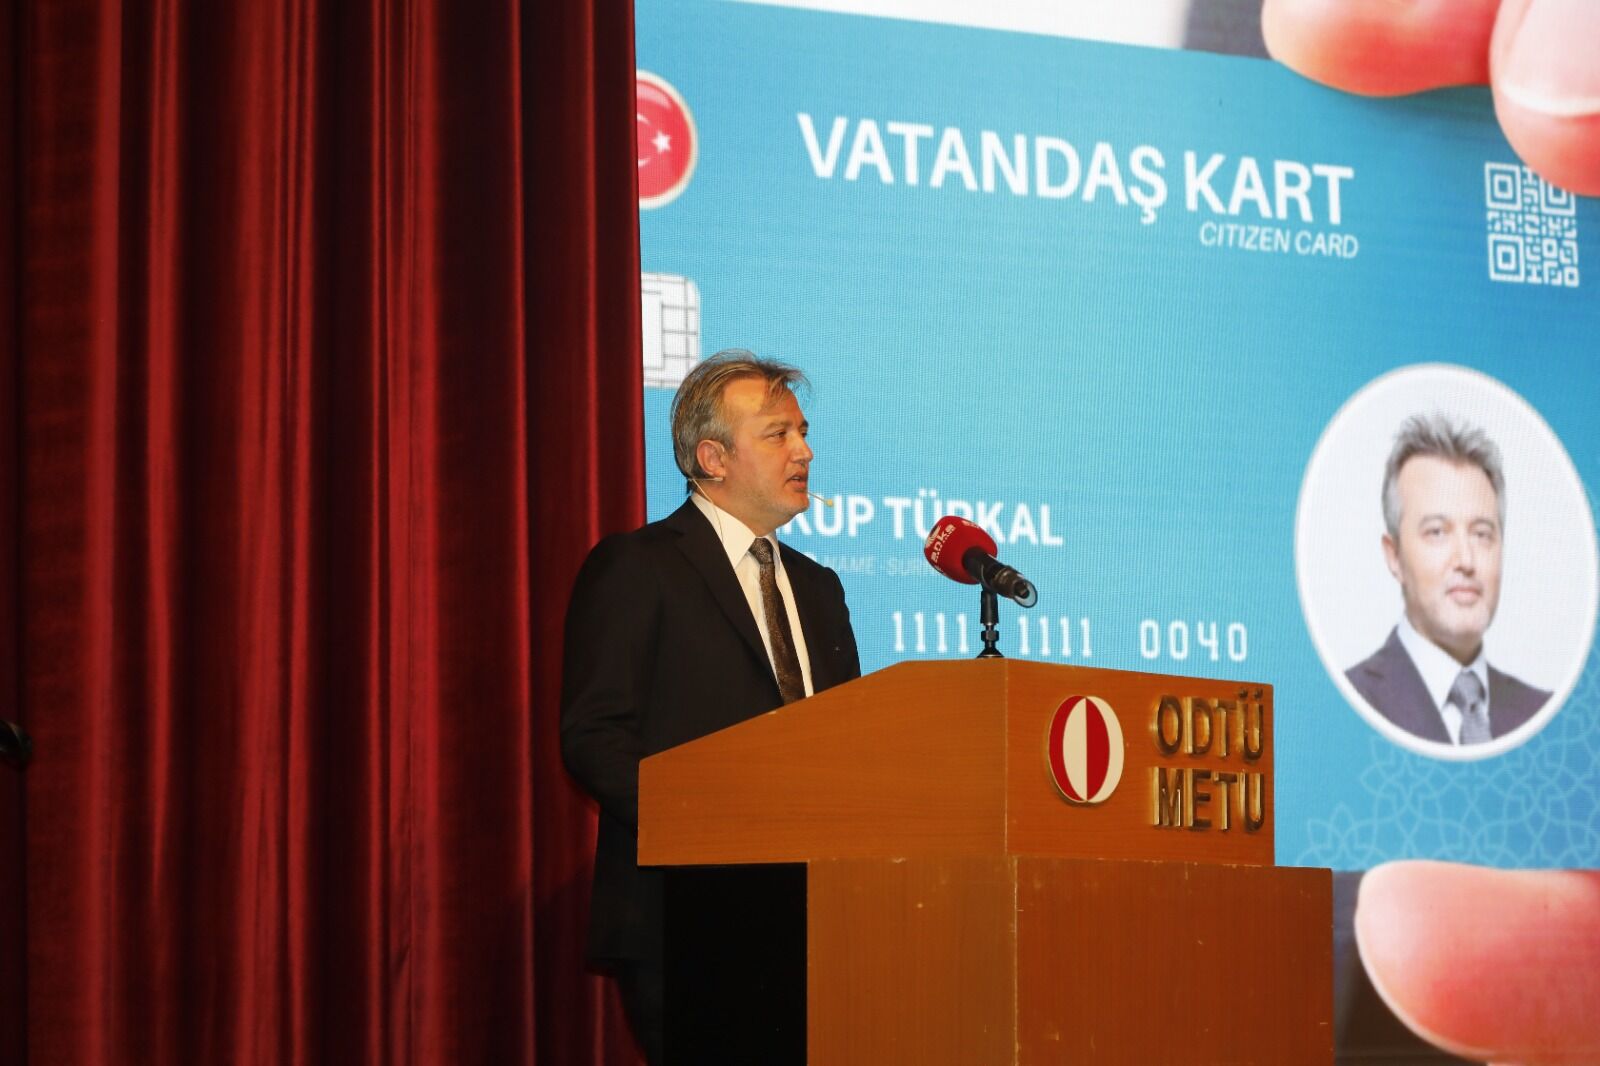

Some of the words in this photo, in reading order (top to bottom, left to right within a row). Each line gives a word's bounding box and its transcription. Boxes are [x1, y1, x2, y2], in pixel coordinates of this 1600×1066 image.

[796, 112, 1168, 225] VATANDAŞ
[1184, 150, 1355, 225] KART
[1199, 221, 1291, 254] CITIZEN
[1294, 230, 1360, 259] CARD
[892, 610, 968, 653] 1111
[1018, 614, 1093, 658] 1111
[1139, 619, 1249, 663] 0040
[1151, 688, 1265, 762] ODTÜ
[1149, 766, 1265, 831] METU
